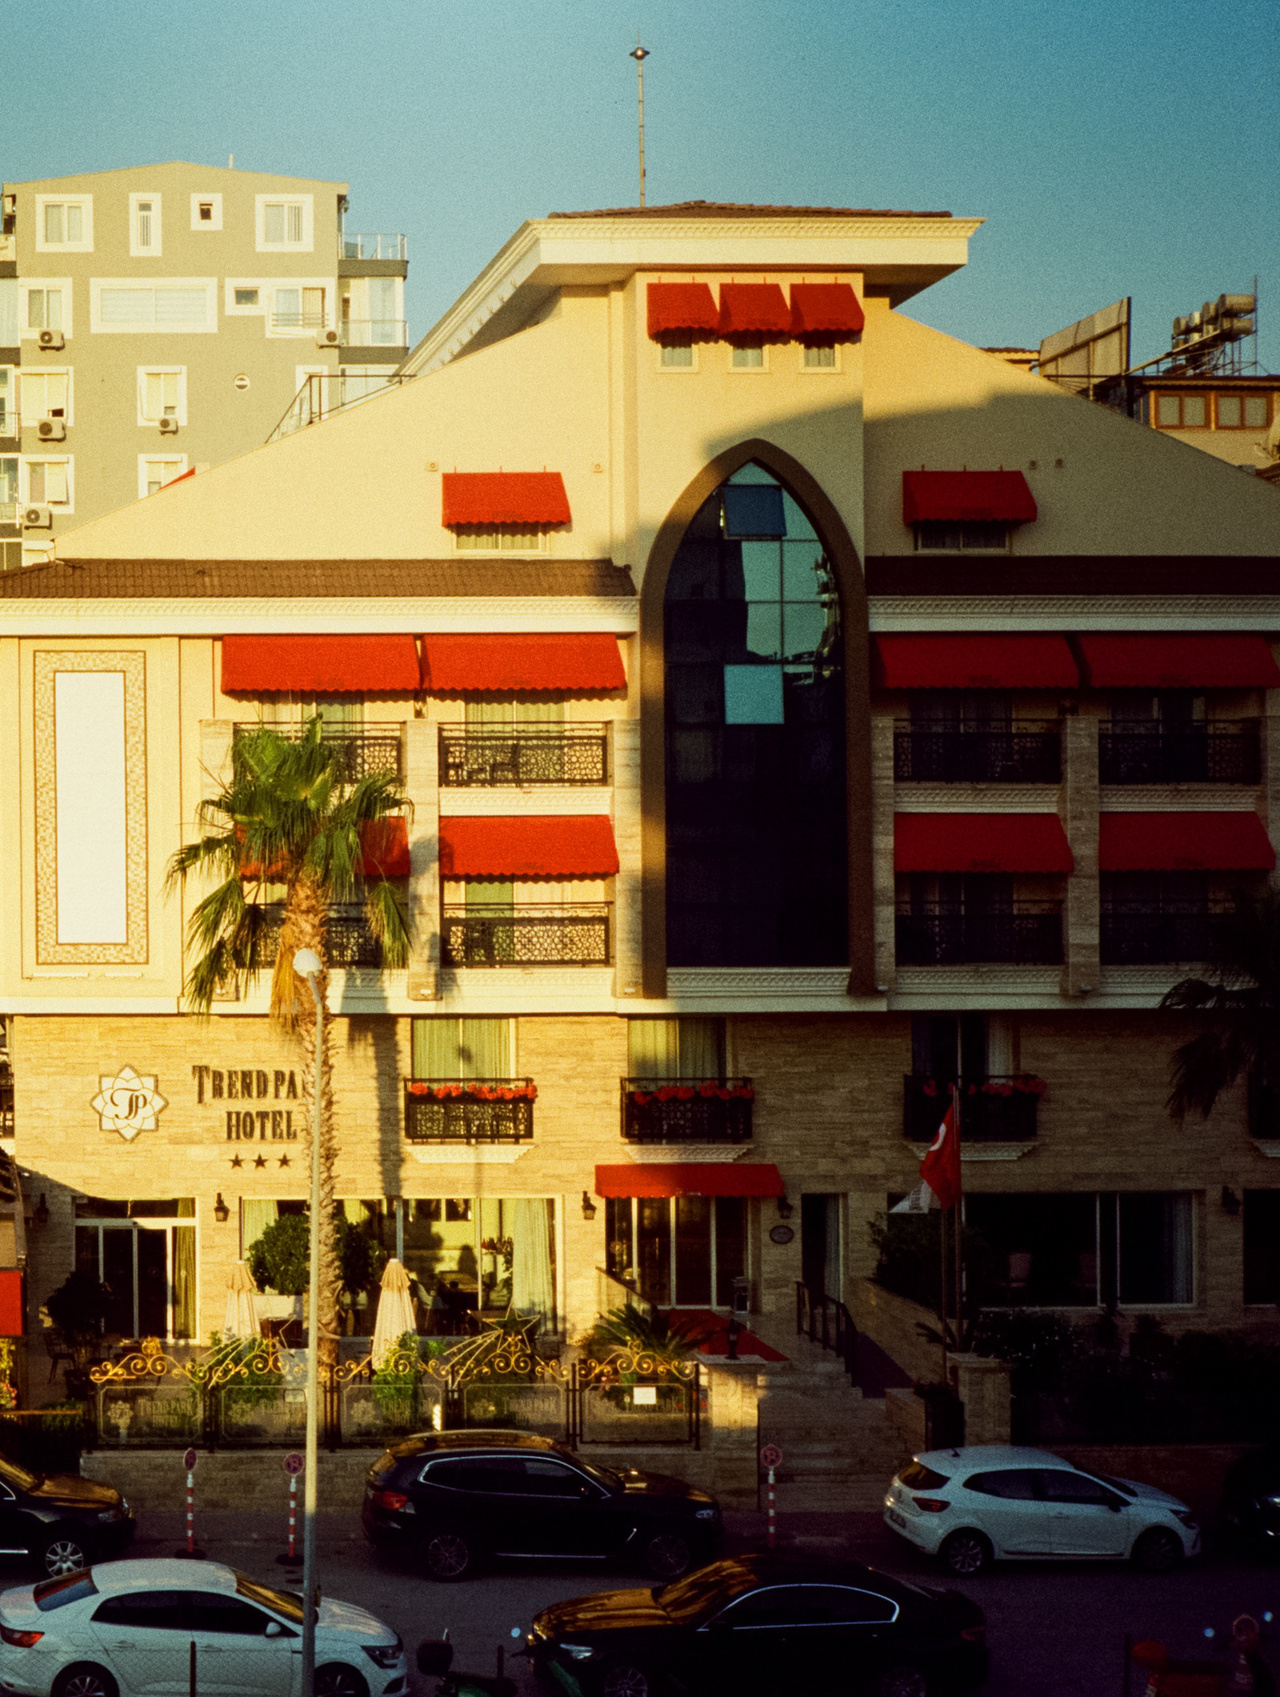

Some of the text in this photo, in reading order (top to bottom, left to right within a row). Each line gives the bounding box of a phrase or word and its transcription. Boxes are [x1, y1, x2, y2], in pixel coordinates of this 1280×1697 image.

[192, 1065, 306, 1104] TREND PA
[226, 1110, 297, 1140] HOTEL
